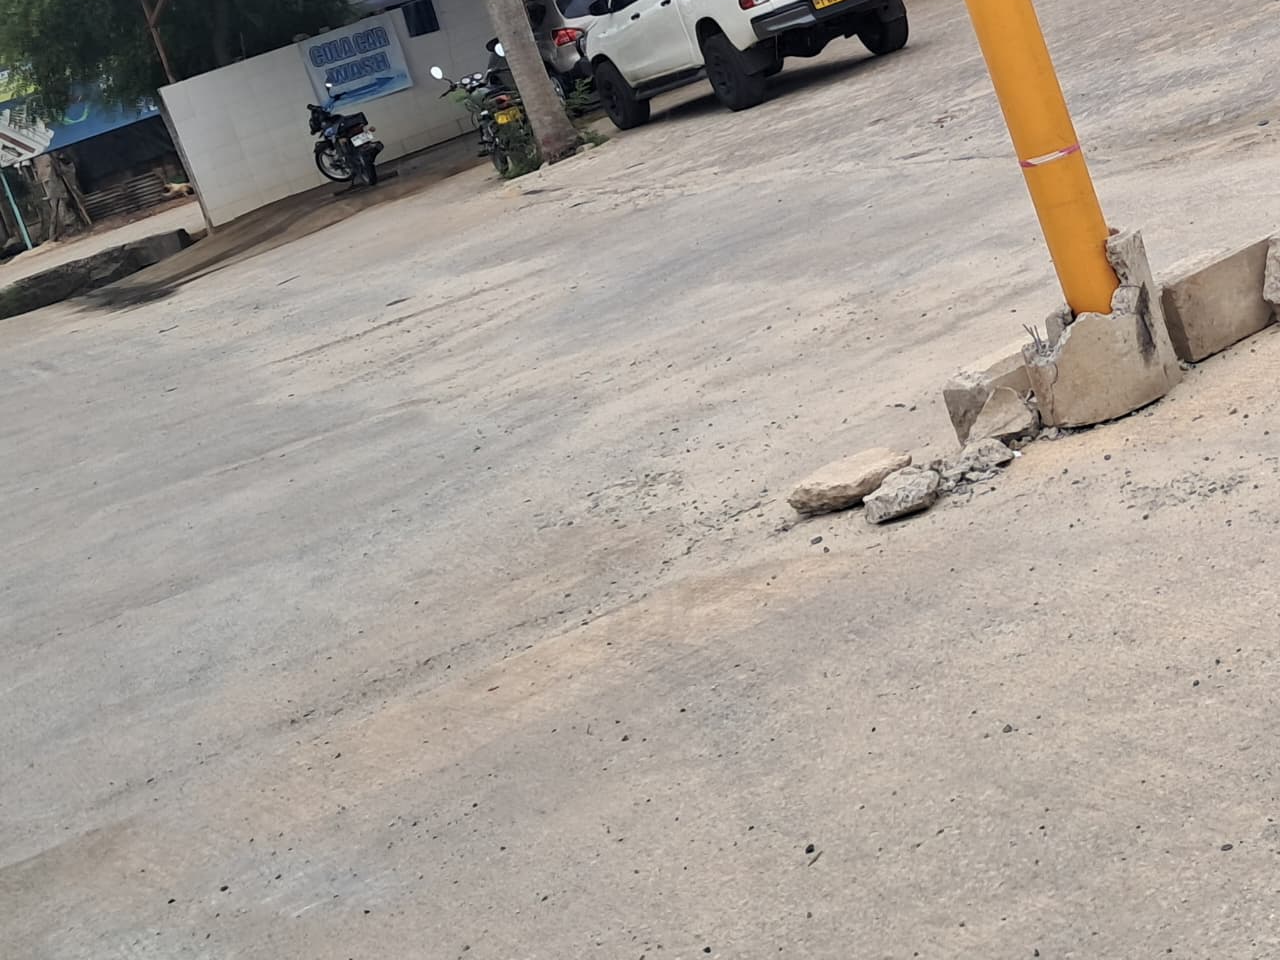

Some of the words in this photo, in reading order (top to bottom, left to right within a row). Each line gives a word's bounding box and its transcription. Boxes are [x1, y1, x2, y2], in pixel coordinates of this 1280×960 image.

[309, 36, 357, 67] COLA
[353, 26, 390, 54] CAR
[325, 51, 391, 86] WASH
